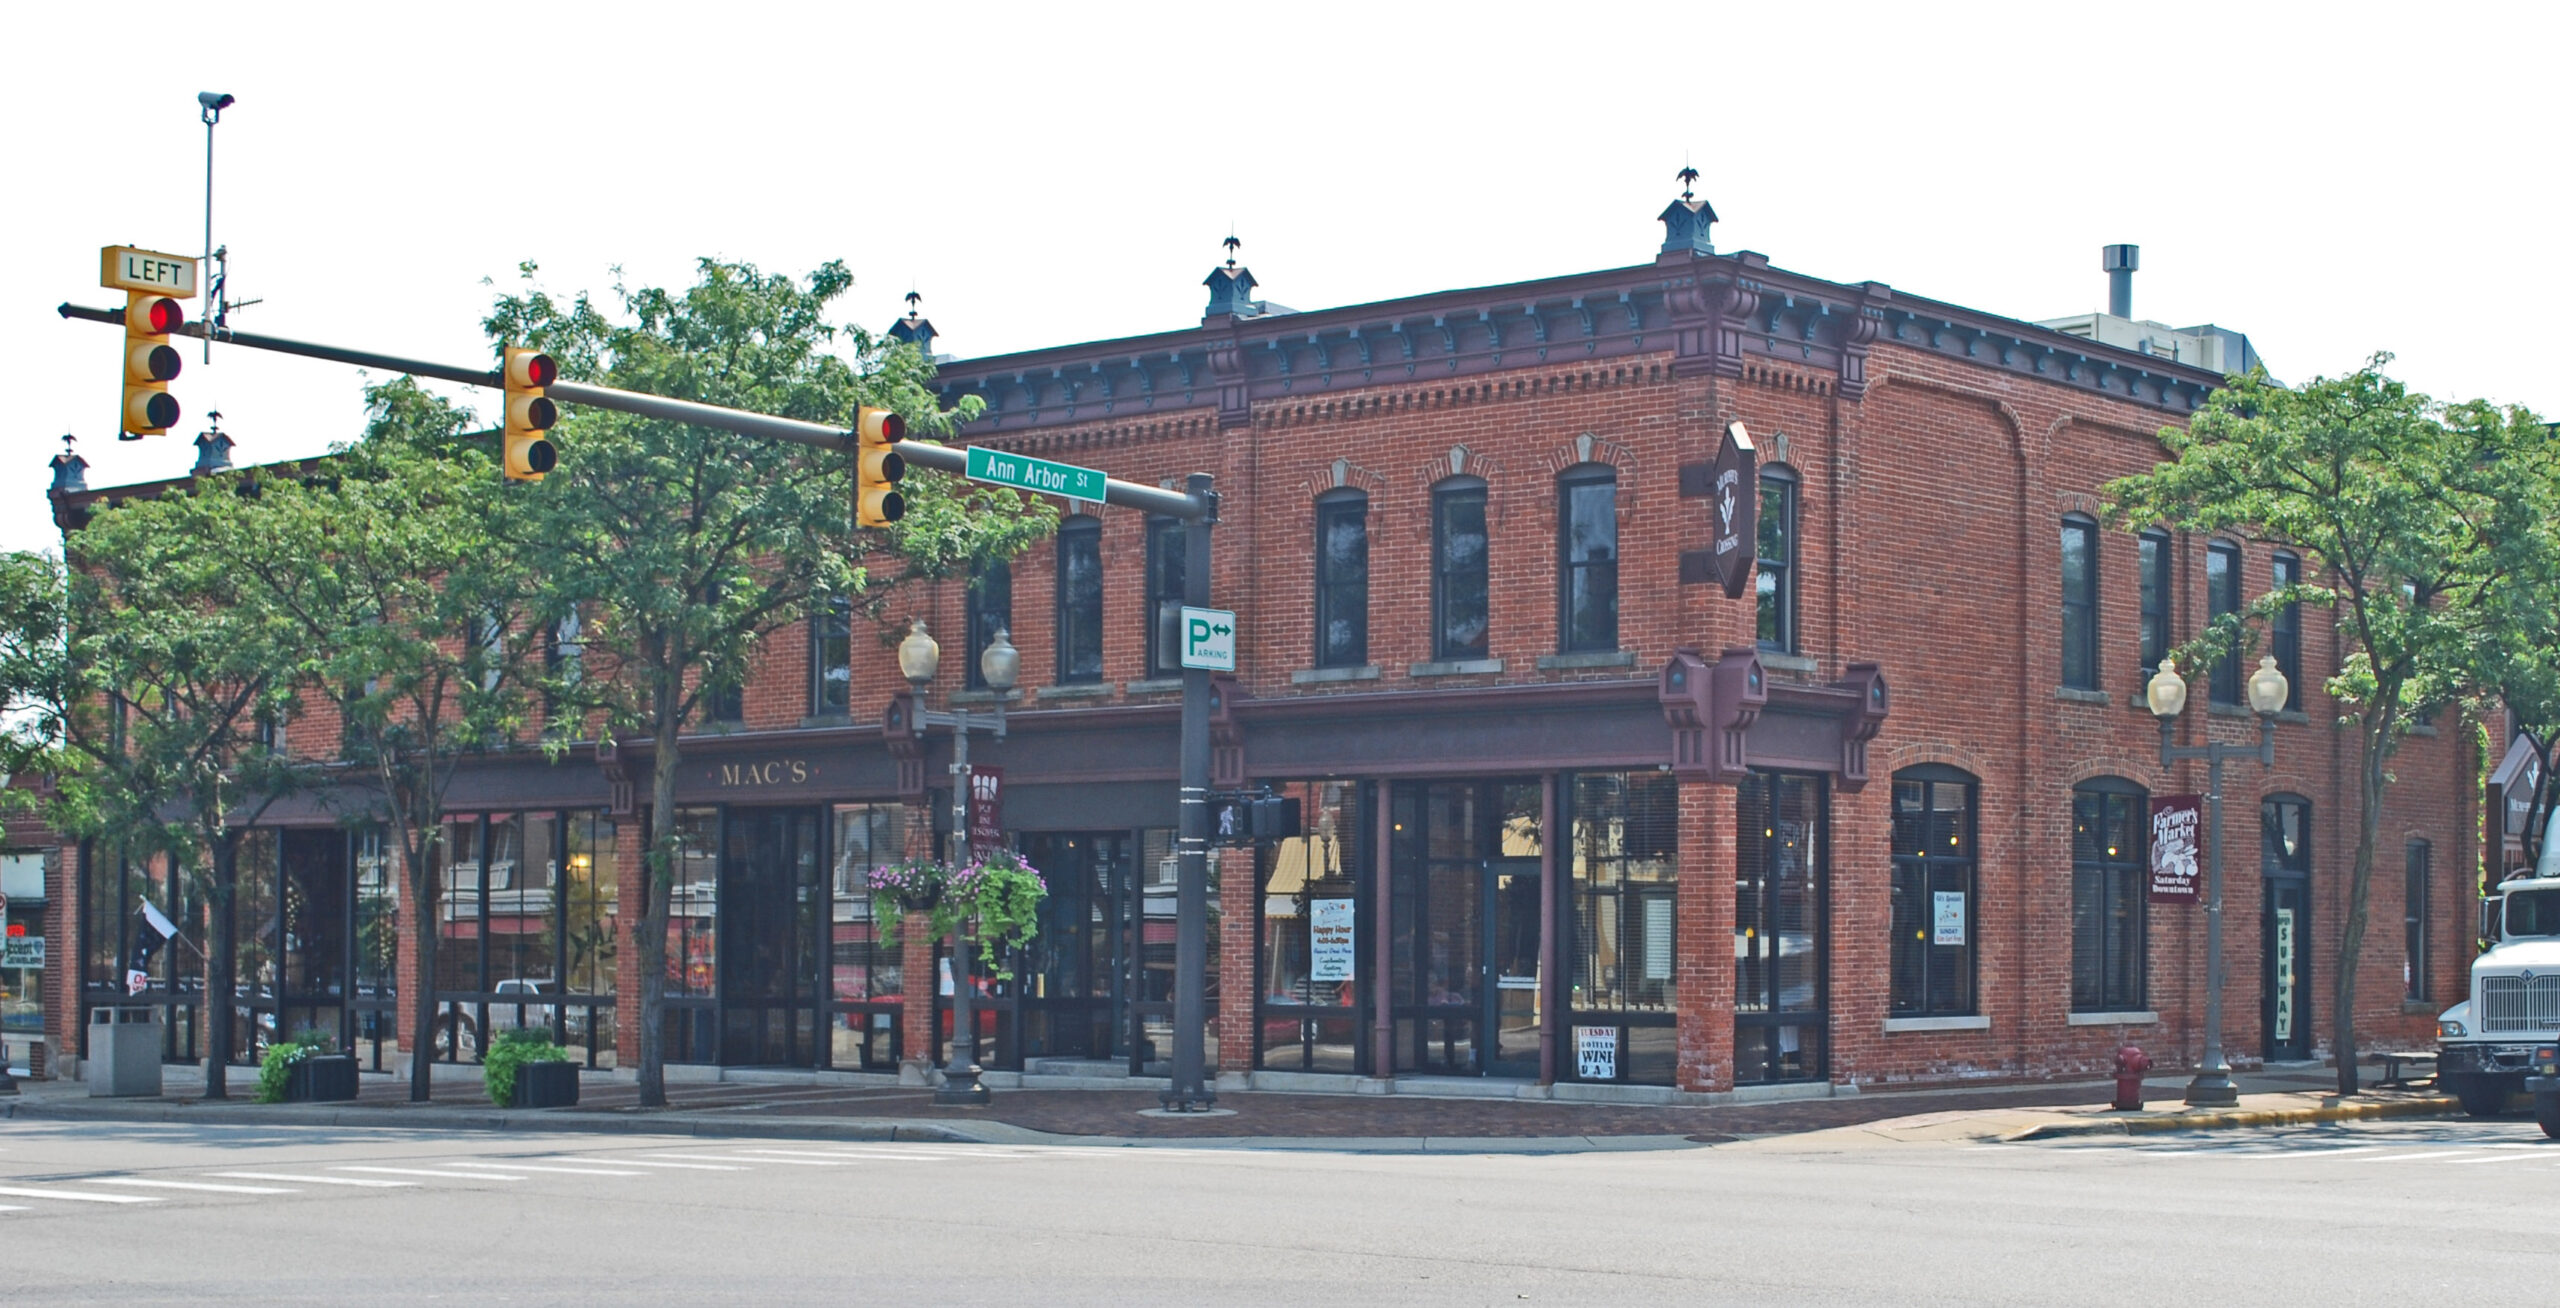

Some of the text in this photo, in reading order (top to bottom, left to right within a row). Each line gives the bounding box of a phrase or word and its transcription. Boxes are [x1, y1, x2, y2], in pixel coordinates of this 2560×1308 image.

[129, 257, 182, 285] LEFT
[986, 455, 1089, 490] Ann Arbor St
[721, 760, 807, 786] MAC'S
[2153, 808, 2198, 835] Farmer's
[2158, 824, 2195, 846] Market
[2152, 885, 2194, 894] Downtown
[2155, 876, 2191, 886] Saturday
[2279, 927, 2288, 1031] SUNDAY
[1580, 1028, 1614, 1037] TUESDAY
[1582, 1050, 1613, 1064] WINE
